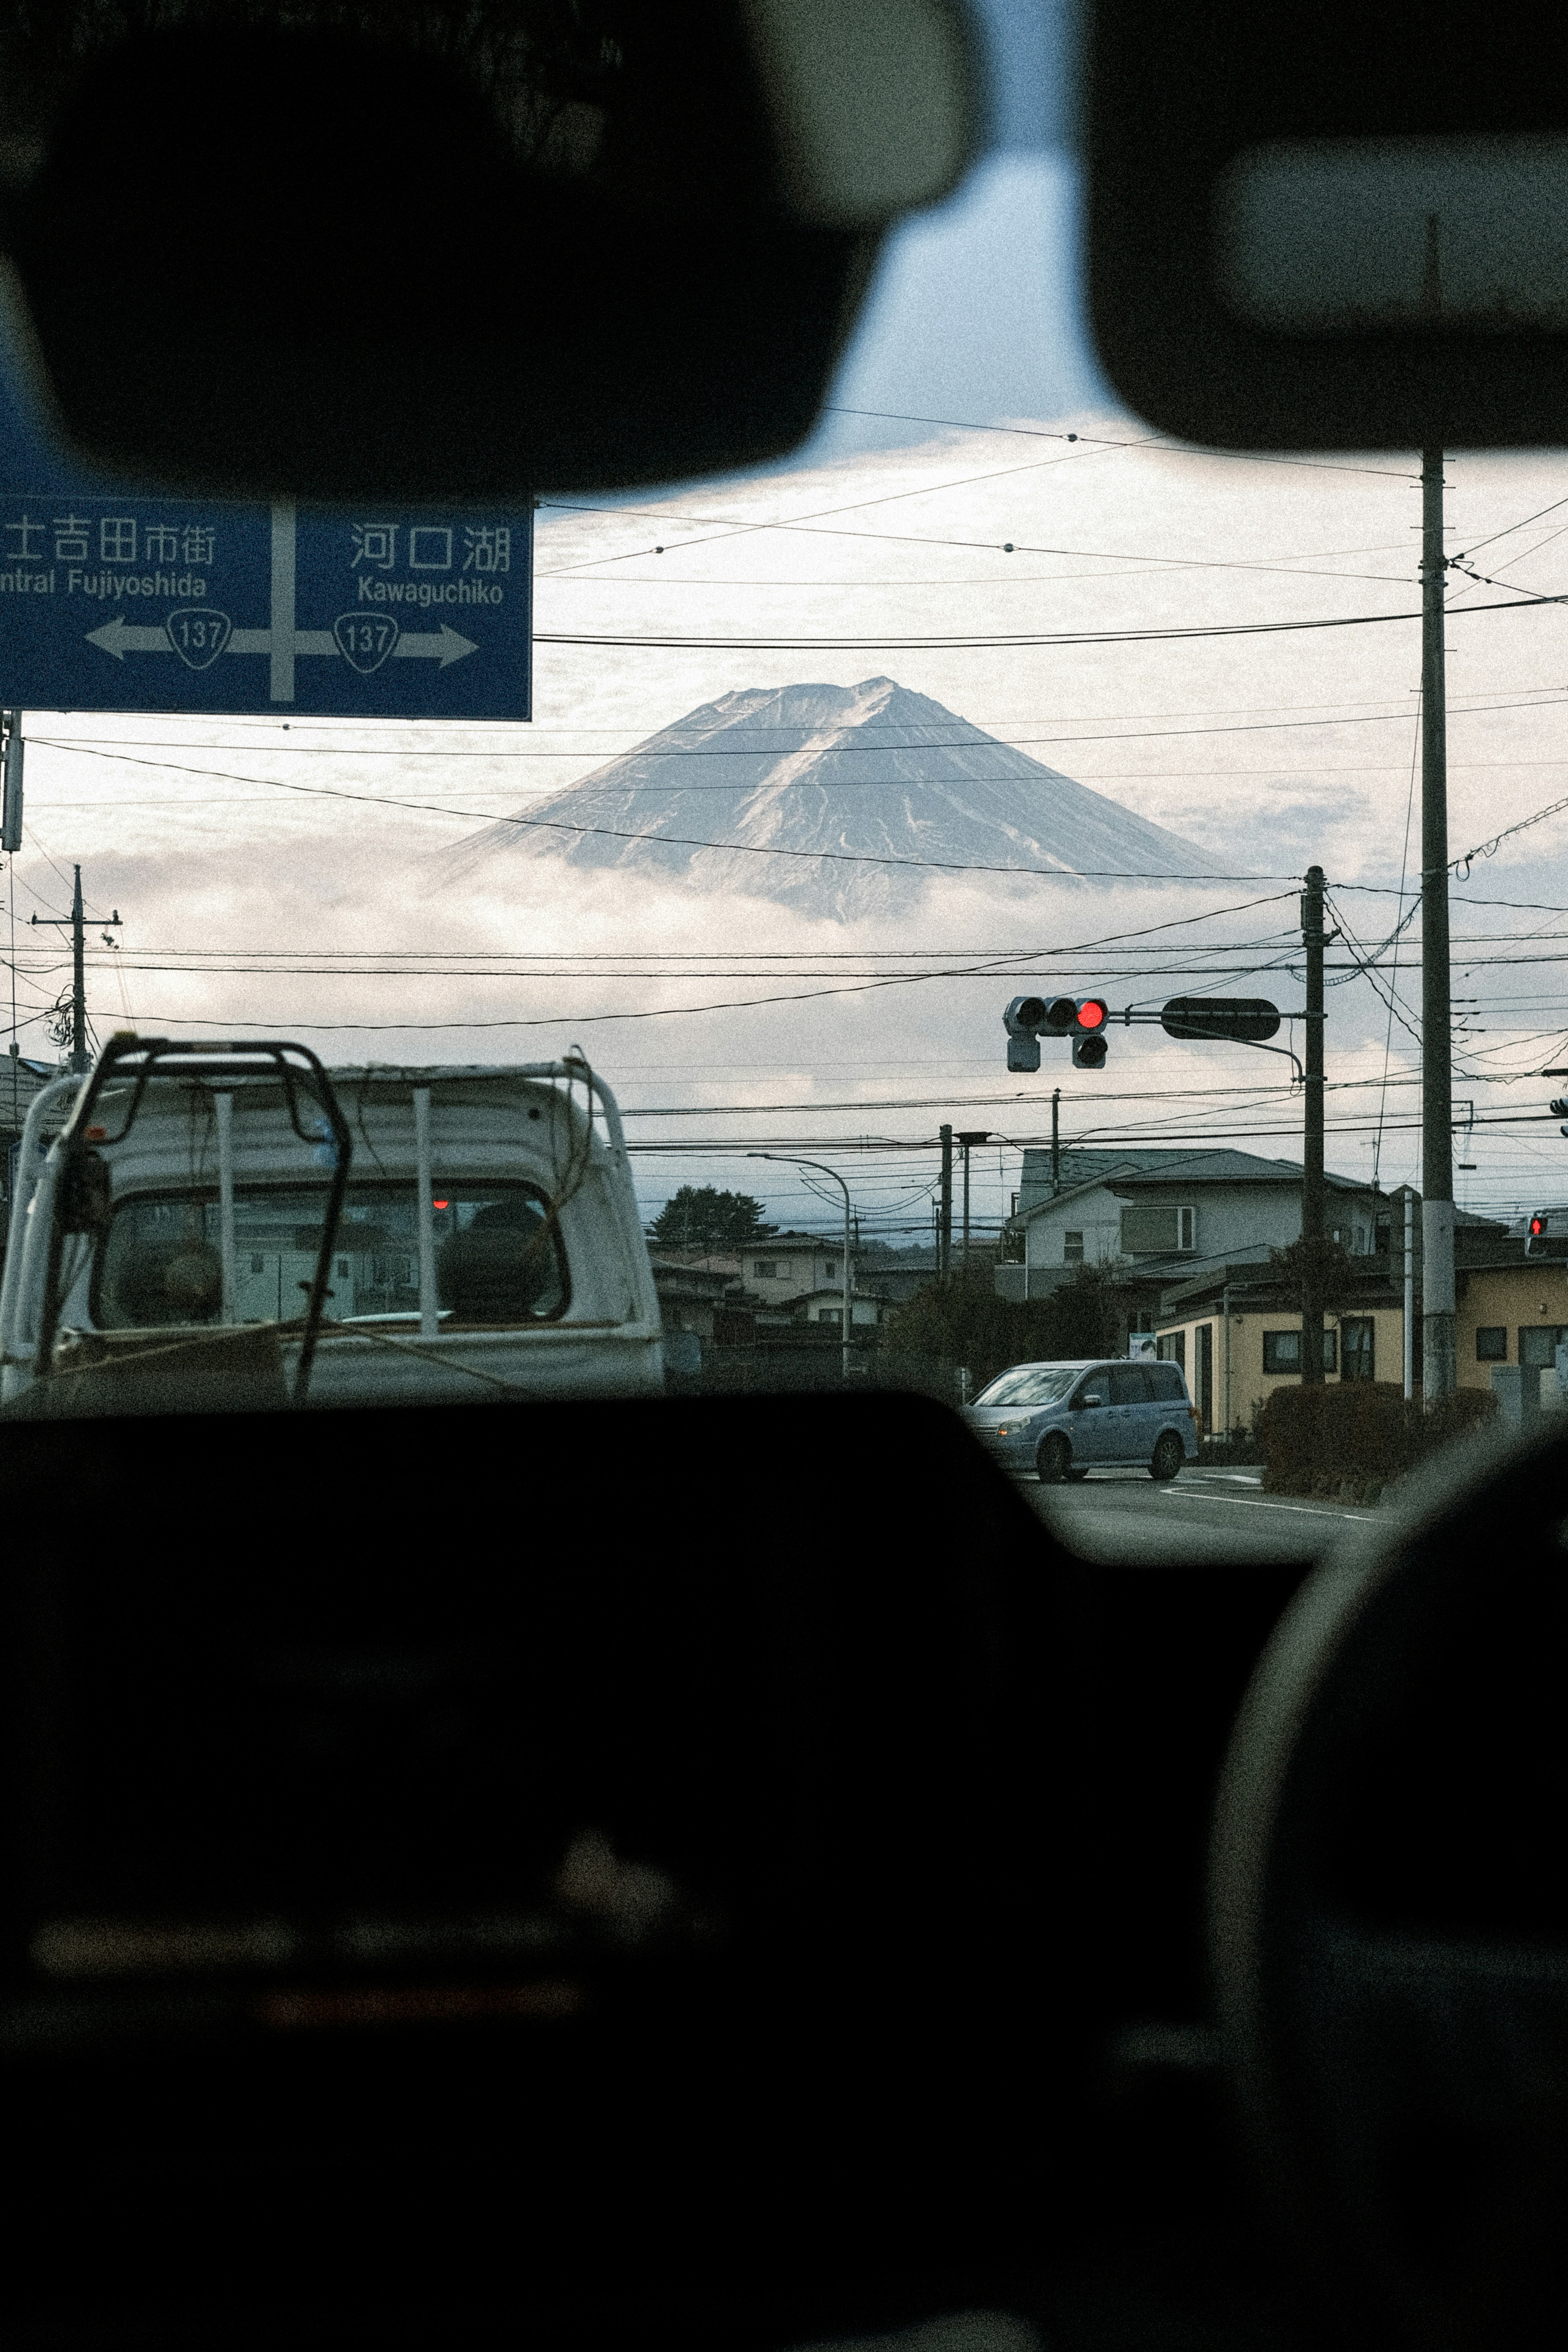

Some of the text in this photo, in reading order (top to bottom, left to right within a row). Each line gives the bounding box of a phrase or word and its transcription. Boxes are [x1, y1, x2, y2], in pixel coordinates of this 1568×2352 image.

[5, 514, 215, 565] 士吉田市街
[351, 523, 511, 573] 河口湖
[69, 569, 206, 600] Fujiyoshida
[358, 576, 503, 608] Kawaguchiko
[180, 621, 221, 648] 137
[346, 625, 388, 652] 137
